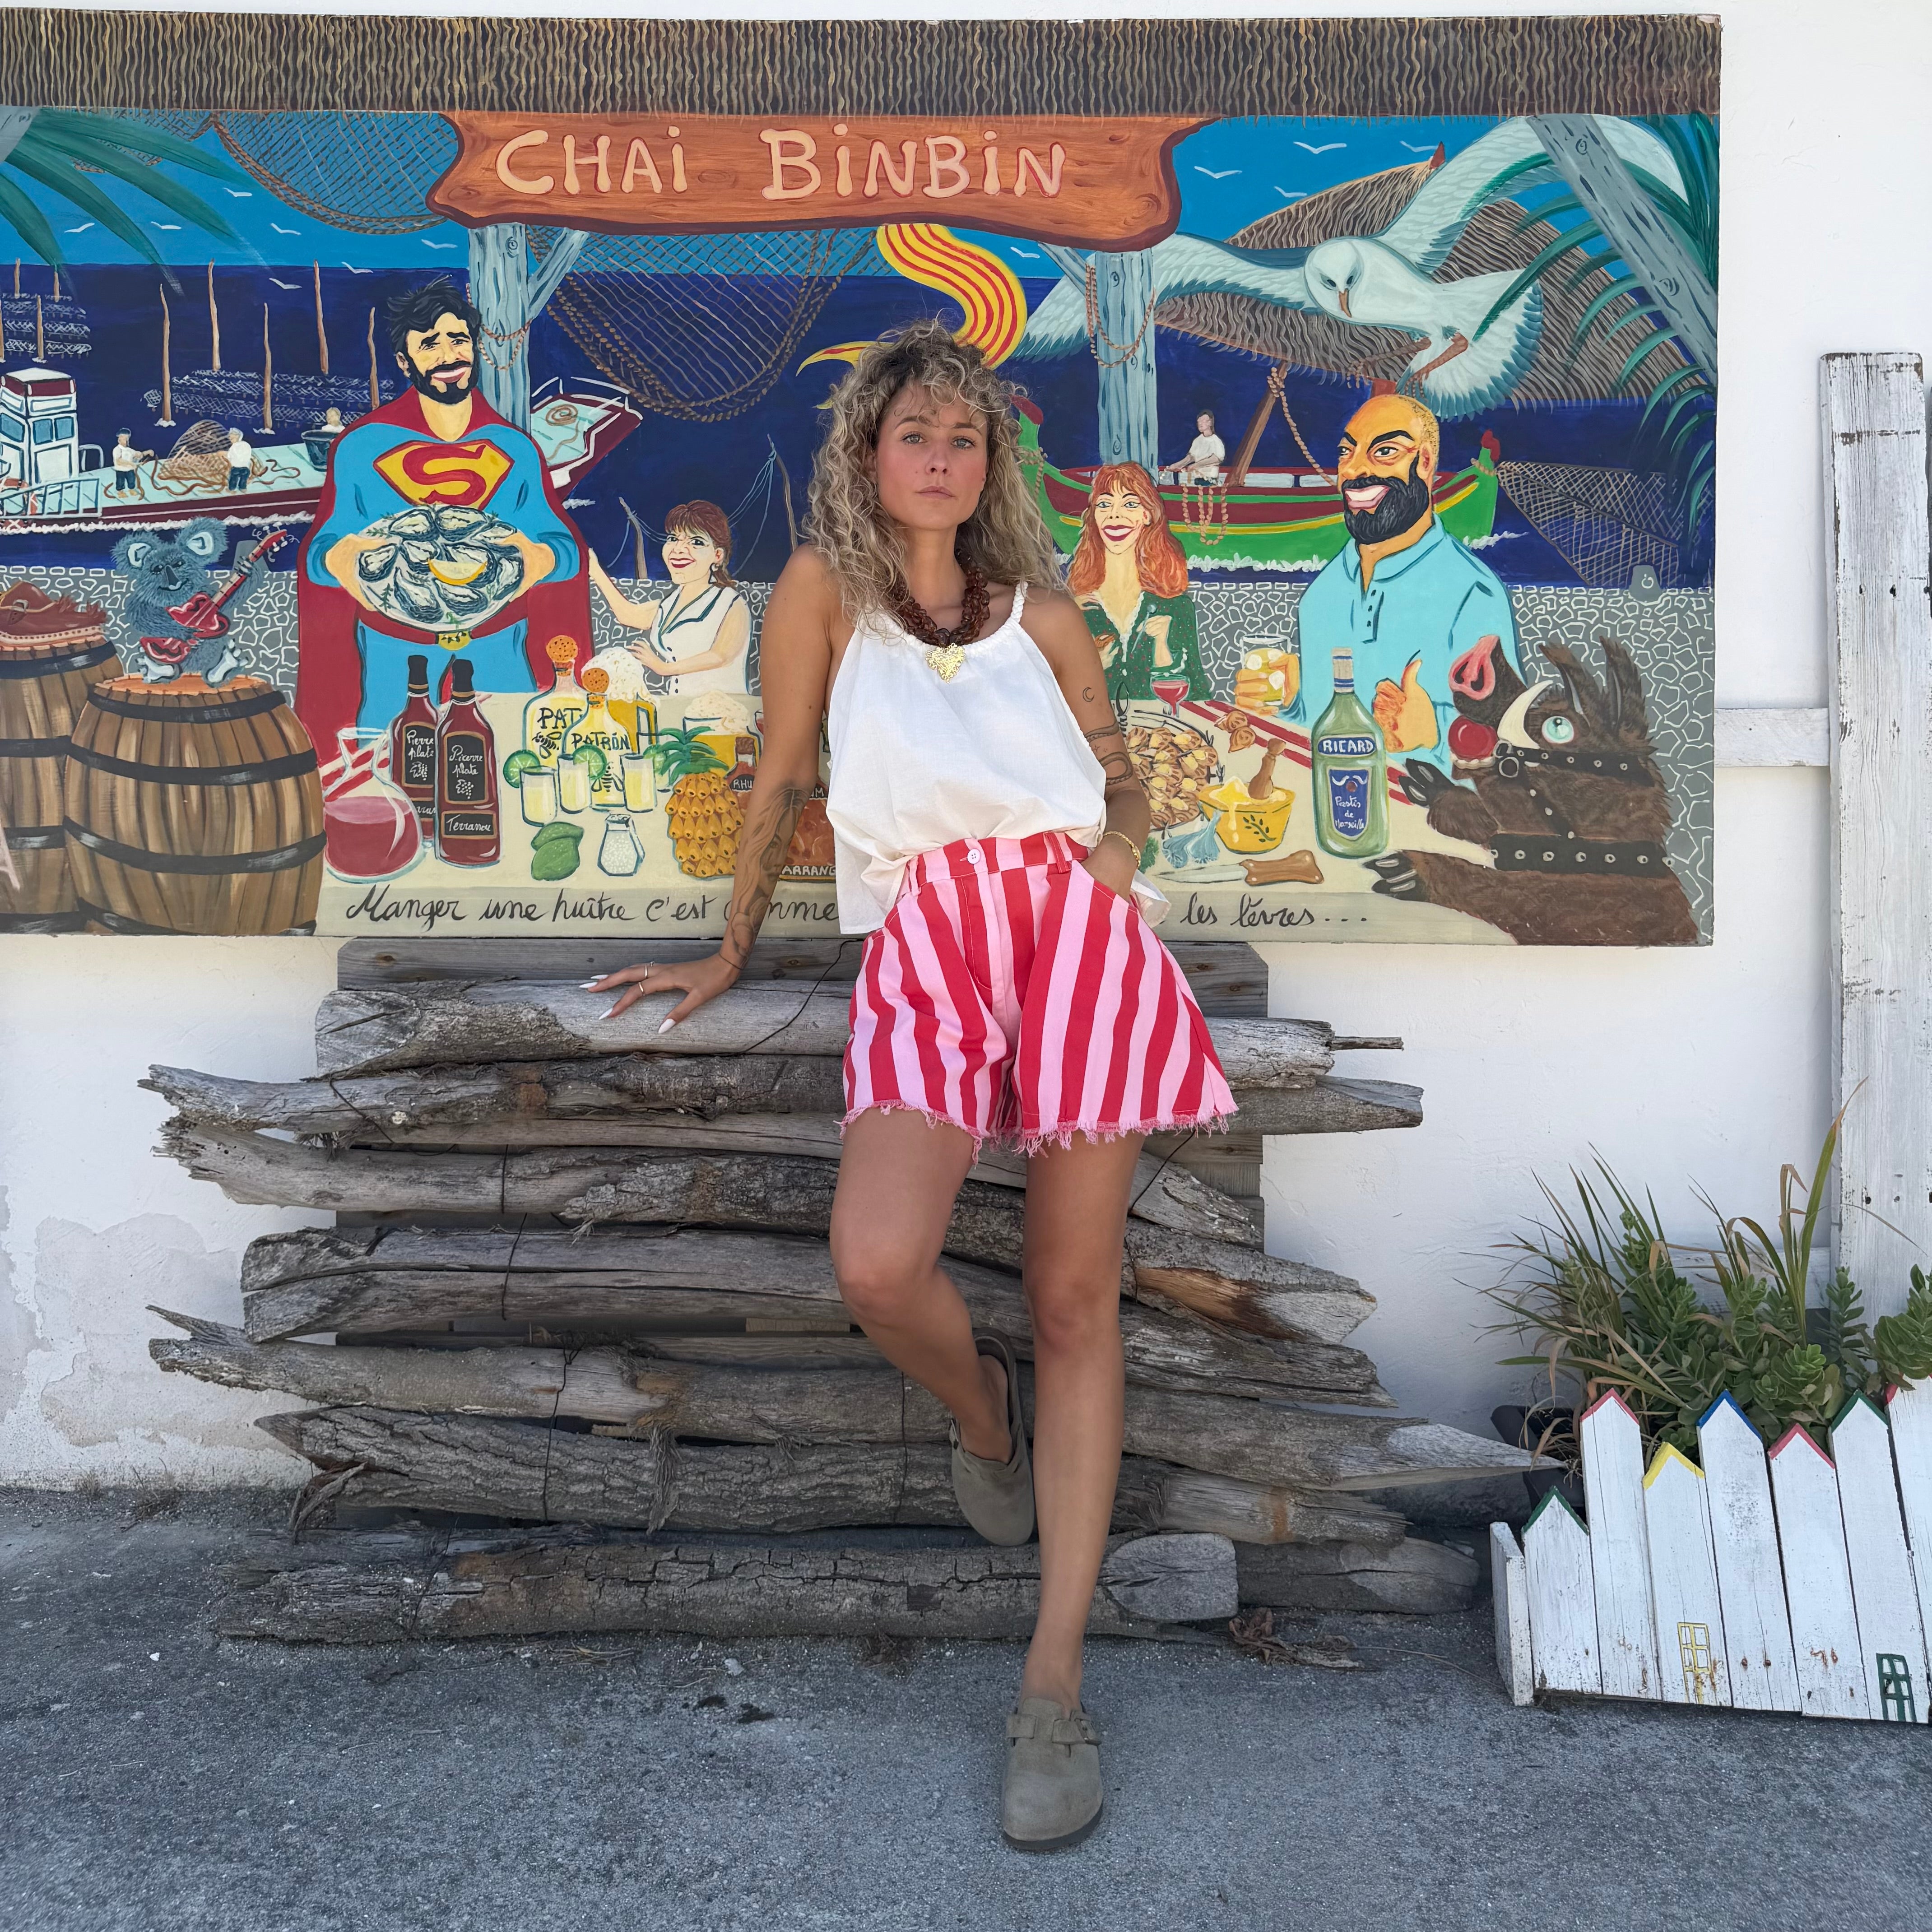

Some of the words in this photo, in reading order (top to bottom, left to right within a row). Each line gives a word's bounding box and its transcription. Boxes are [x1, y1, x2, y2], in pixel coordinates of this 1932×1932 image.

[537, 707, 583, 729] PAT
[1323, 739, 1374, 752] RICARD
[452, 762, 478, 776] plate
[733, 779, 752, 790] RHU
[1344, 810, 1354, 818] de
[781, 865, 836, 876] ARRANG
[346, 884, 467, 933] Manger
[478, 899, 549, 921] une
[724, 901, 839, 921] cmme
[1180, 892, 1217, 925] les
